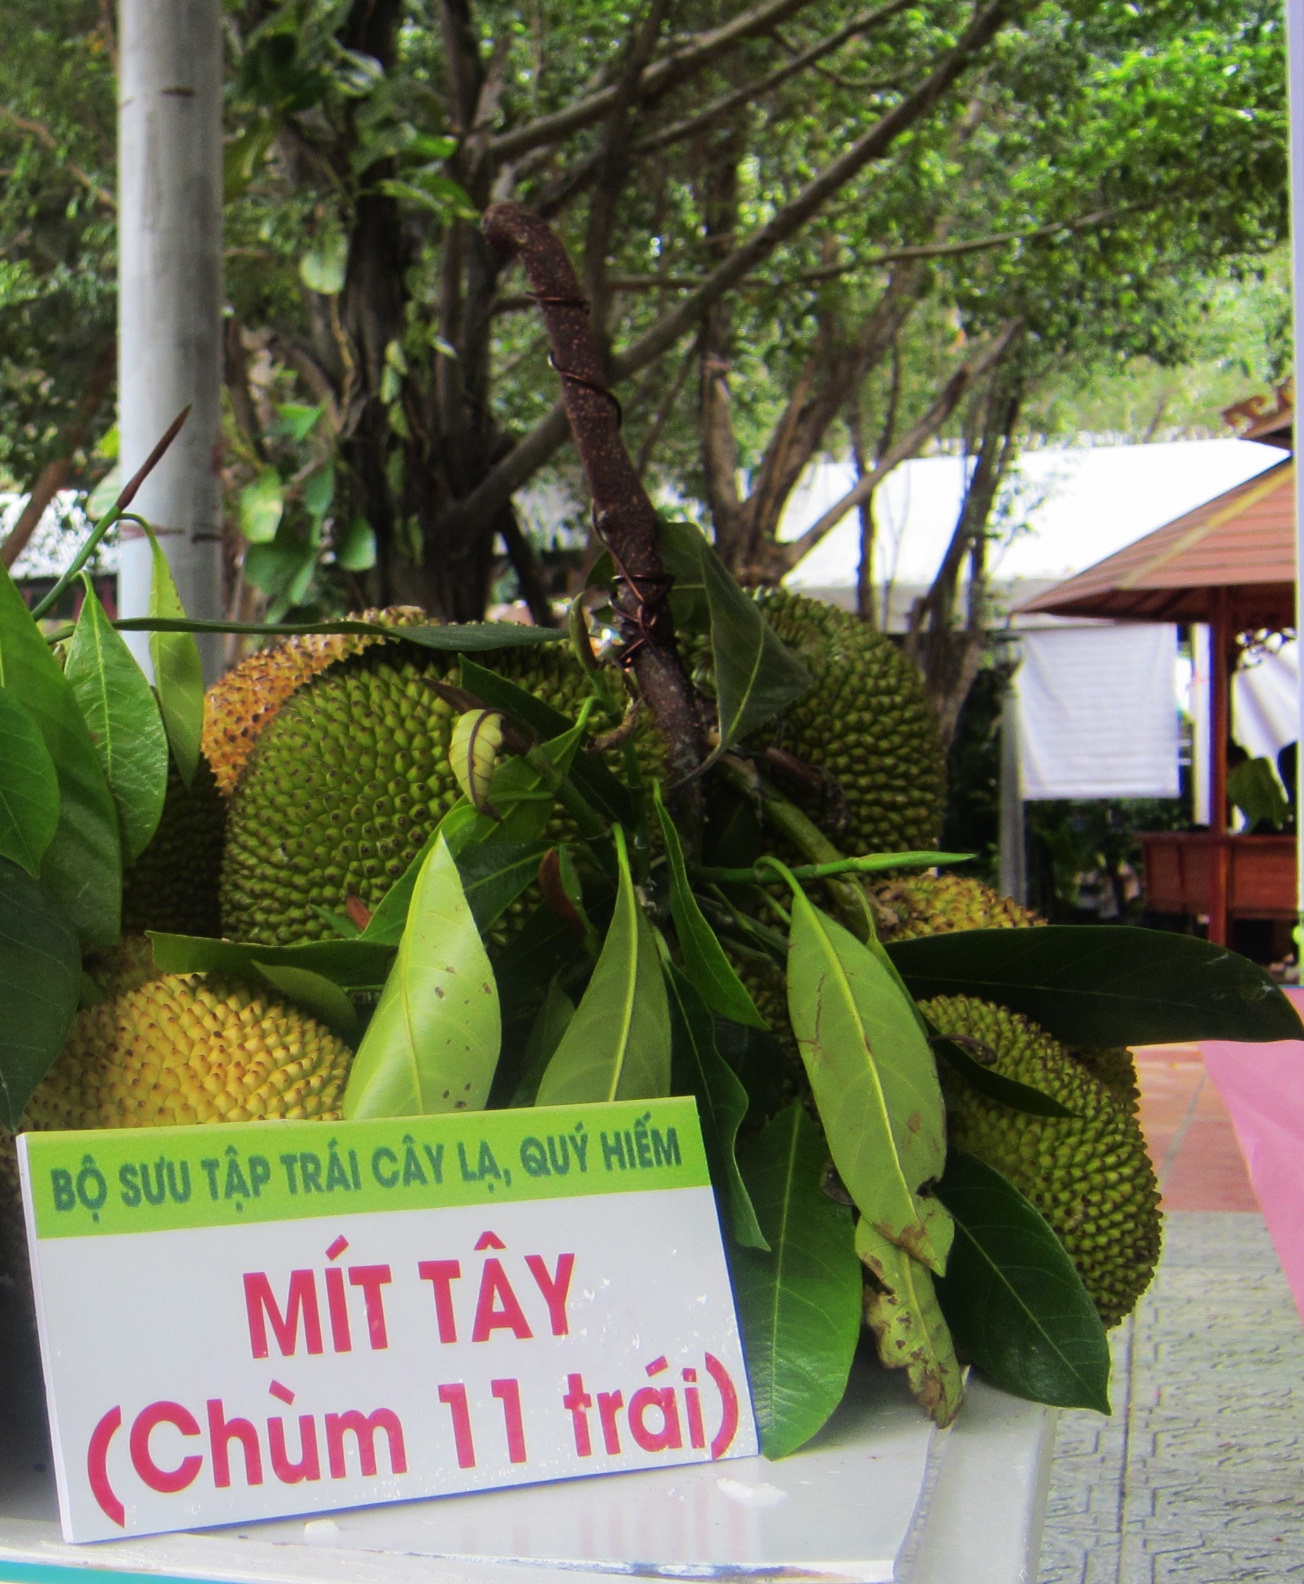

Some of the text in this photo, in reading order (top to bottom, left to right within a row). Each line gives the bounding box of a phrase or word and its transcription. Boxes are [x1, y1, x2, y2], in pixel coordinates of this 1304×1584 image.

[50, 1112, 683, 1222] BỘ SƯU TẬP TRÁI CÂY LẠ, QUÝ HIẾM
[242, 1231, 575, 1360] MÍT TÂY
[87, 1351, 739, 1529] (Chùm 11 trái)
